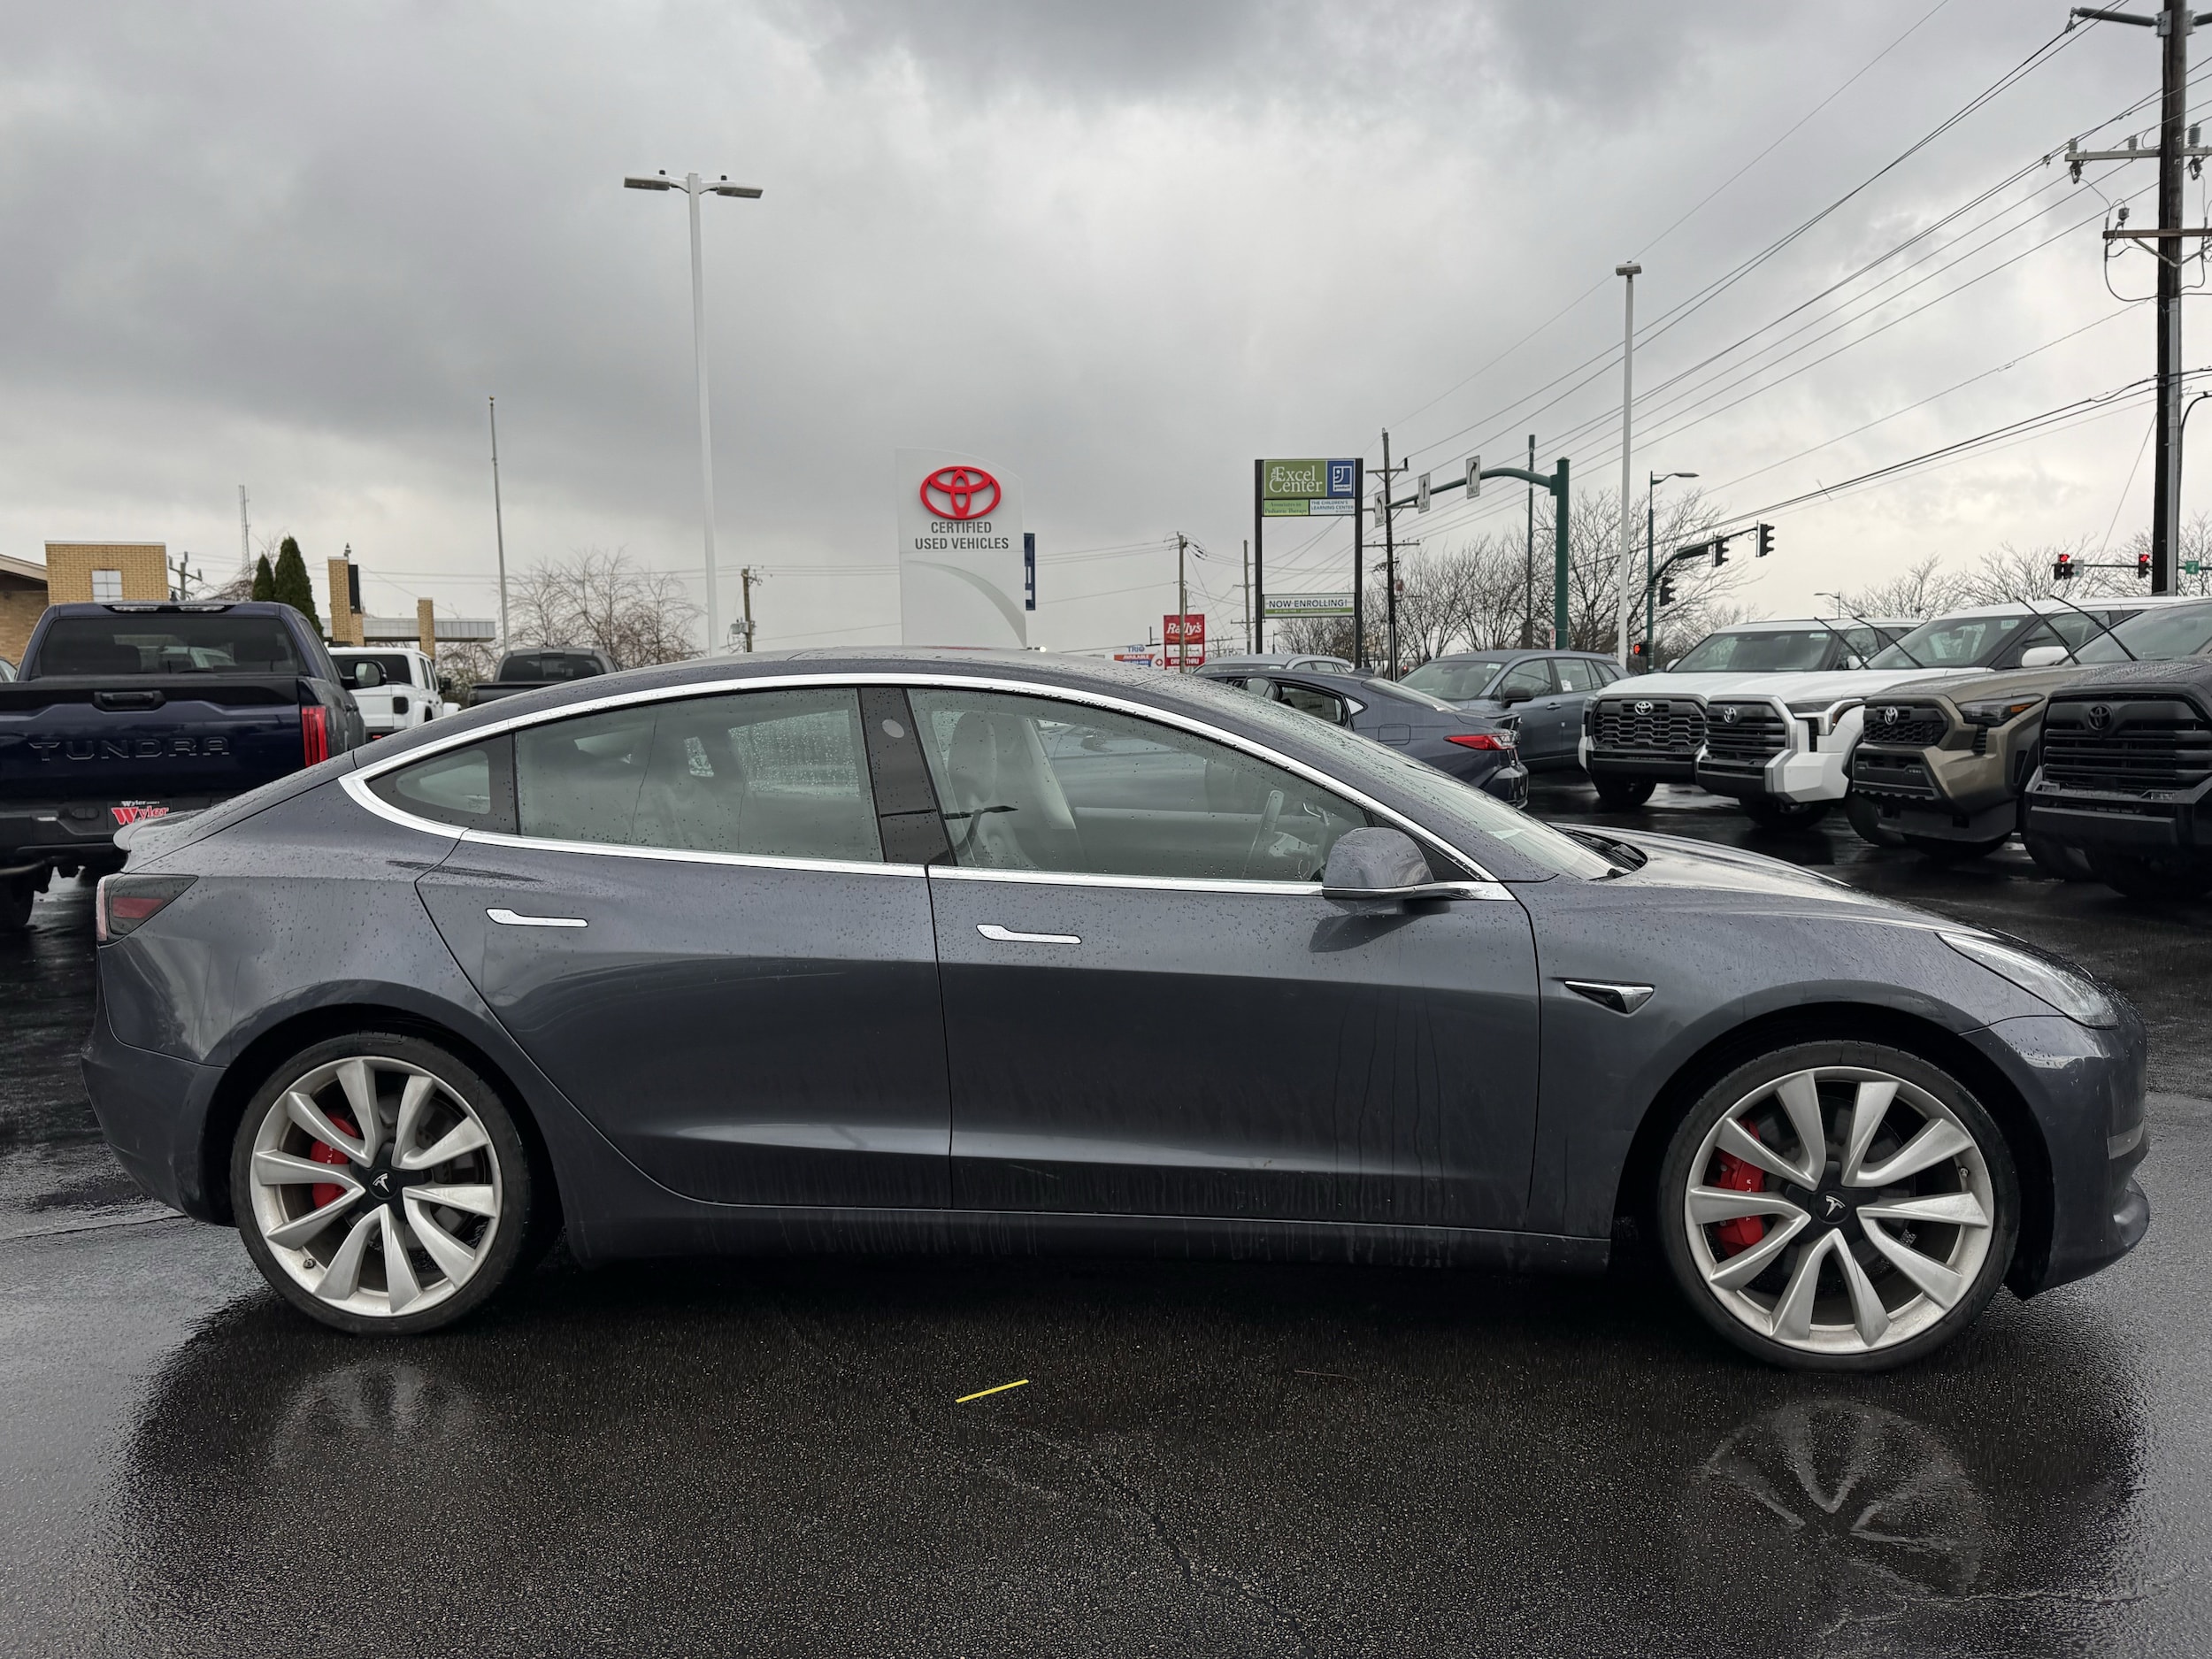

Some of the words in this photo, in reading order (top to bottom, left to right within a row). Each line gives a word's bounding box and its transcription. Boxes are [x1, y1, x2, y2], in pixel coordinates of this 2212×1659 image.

[1274, 465, 1316, 481] Excel
[1269, 478, 1323, 493] Center
[931, 521, 992, 534] CERTIFIED
[915, 538, 948, 549] USED
[952, 537, 1009, 549] VEHICLES
[28, 735, 231, 761] TUNDRA
[111, 805, 170, 825] Wyler
